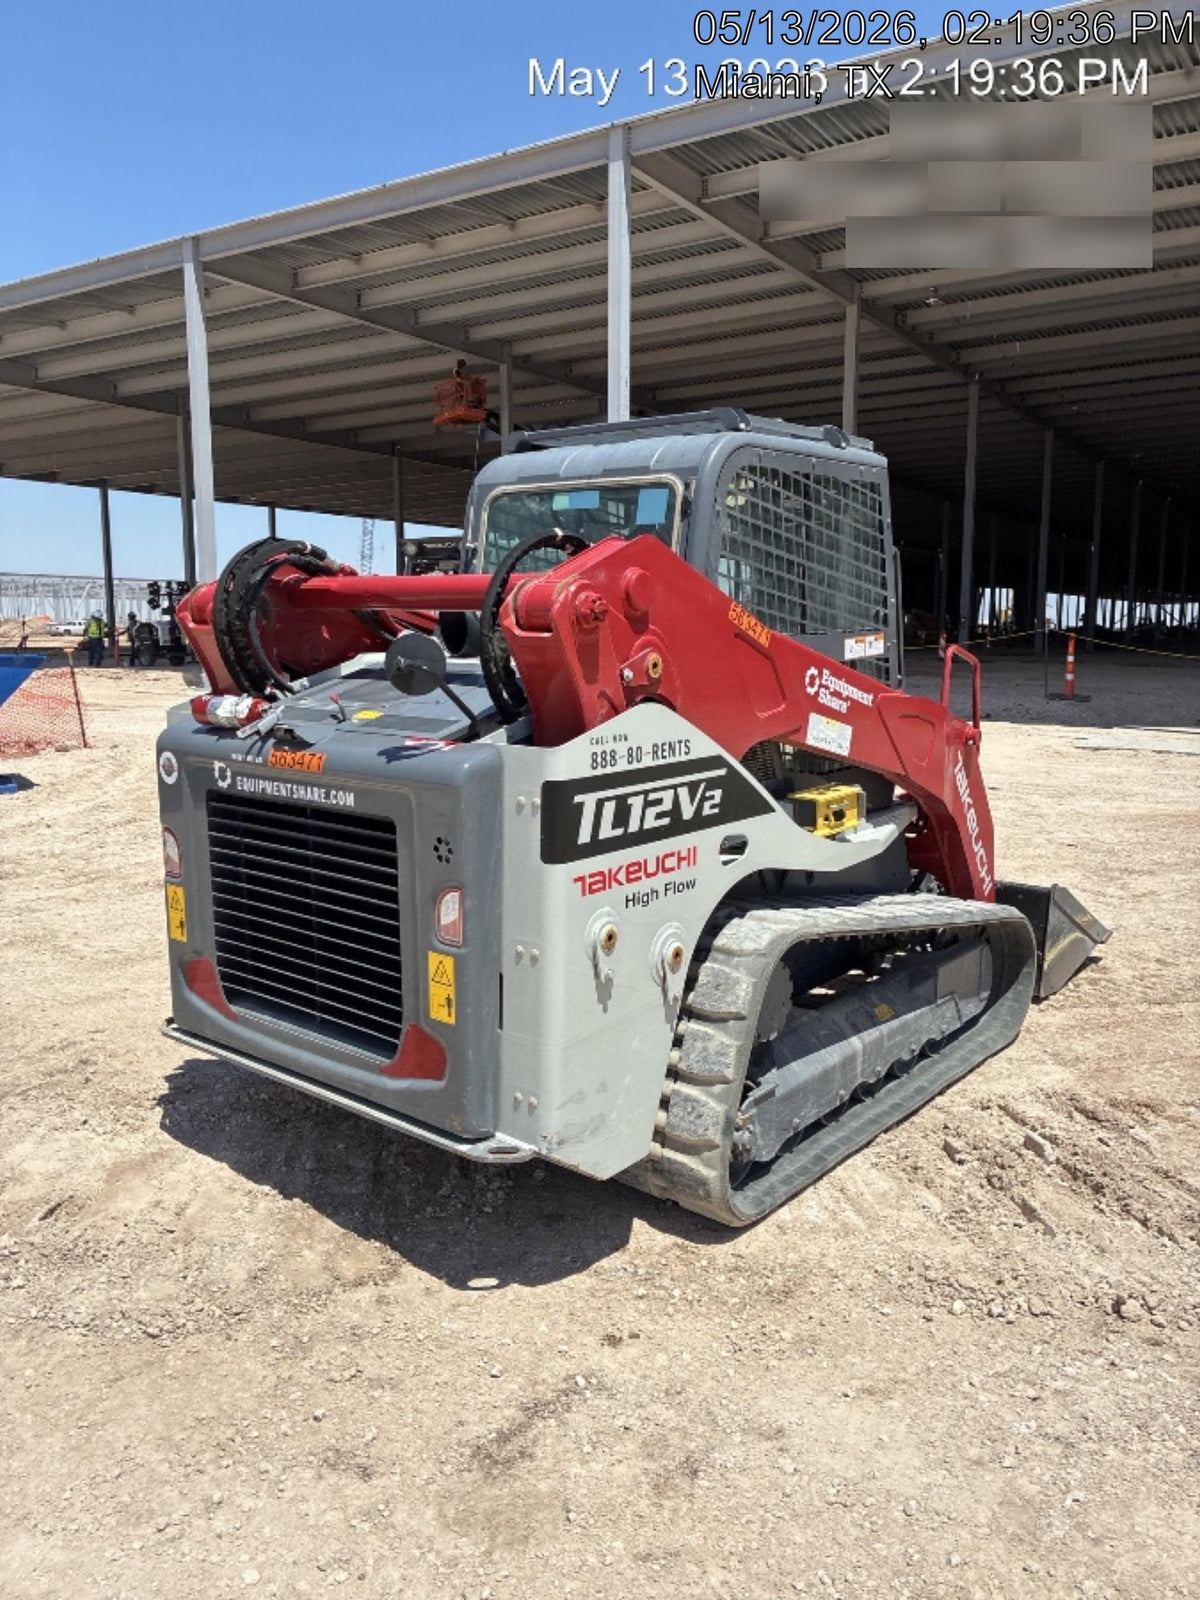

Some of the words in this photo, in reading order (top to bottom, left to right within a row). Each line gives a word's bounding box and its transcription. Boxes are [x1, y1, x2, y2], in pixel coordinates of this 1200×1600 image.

[821, 668, 874, 707] Equipment
[269, 750, 324, 773] 563471
[591, 739, 691, 770] 888-80-RENTS
[235, 776, 355, 807] EQUIPMENTSHARE.COM
[573, 845, 698, 897] TAKEUCHI
[625, 887, 659, 909] High
[664, 878, 697, 897] Flow
